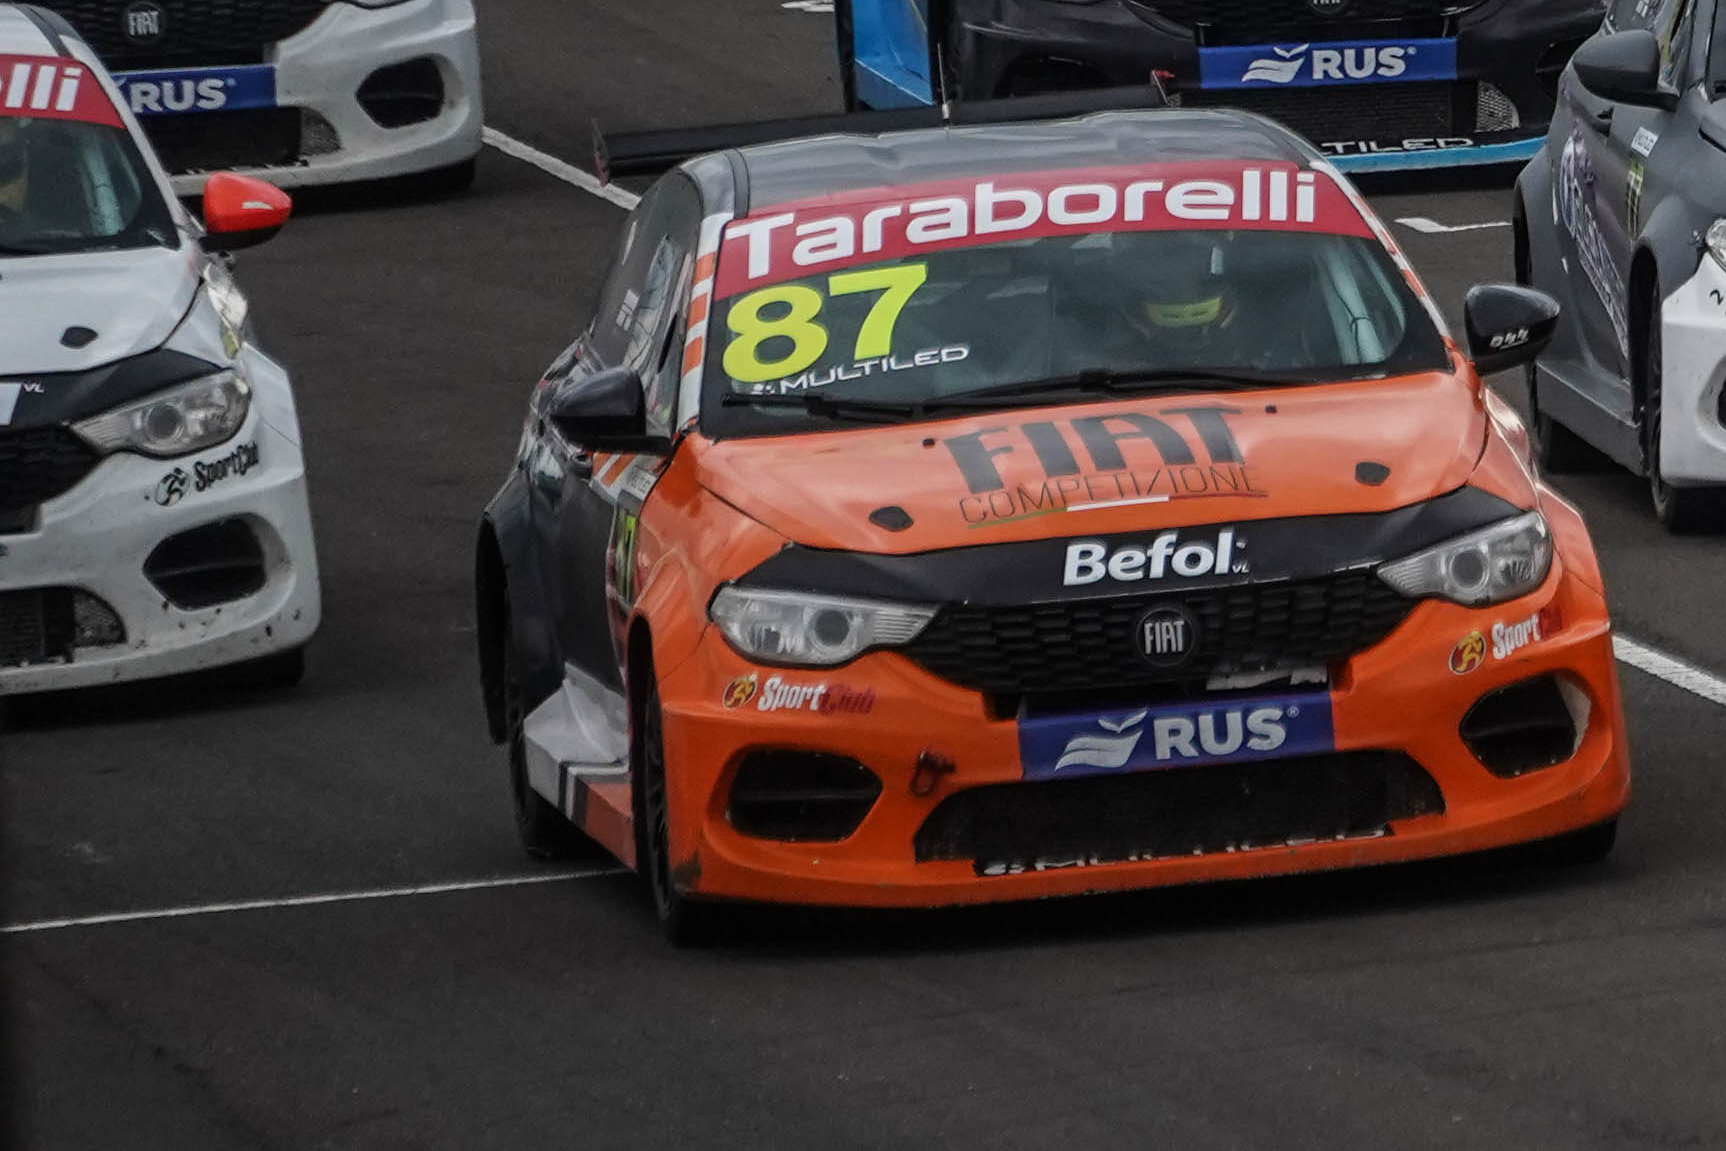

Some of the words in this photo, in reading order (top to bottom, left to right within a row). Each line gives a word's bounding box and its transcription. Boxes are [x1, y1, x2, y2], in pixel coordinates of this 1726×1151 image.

[127, 8, 160, 36] FIAT
[723, 169, 1316, 280] Taraborelli
[721, 264, 929, 385] 87
[779, 344, 971, 394] MULTILED
[942, 406, 1246, 495] FIAT
[958, 464, 1268, 525] COMPETIZIONE
[1062, 528, 1234, 587] Befol
[1143, 619, 1185, 655] FIAT
